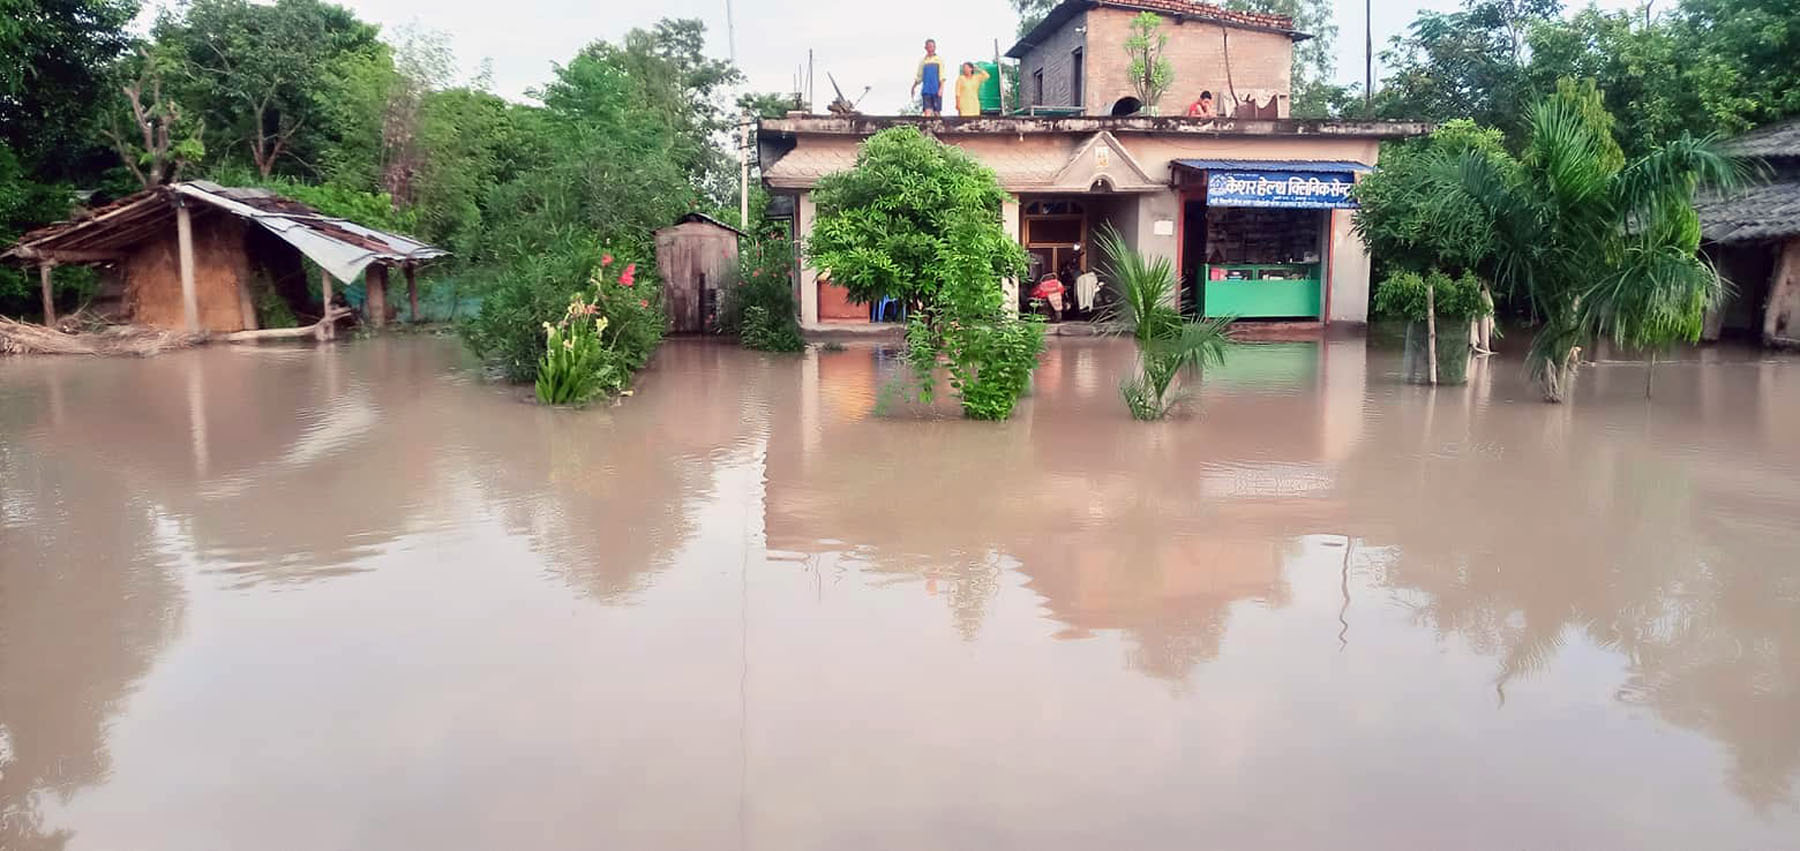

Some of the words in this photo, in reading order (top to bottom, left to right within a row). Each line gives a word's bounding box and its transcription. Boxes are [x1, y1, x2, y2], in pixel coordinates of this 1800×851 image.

[1257, 176, 1286, 196] हेल्थ
[1287, 176, 1330, 195] क्लिनिक
[1330, 178, 1353, 196] सेन्ट
